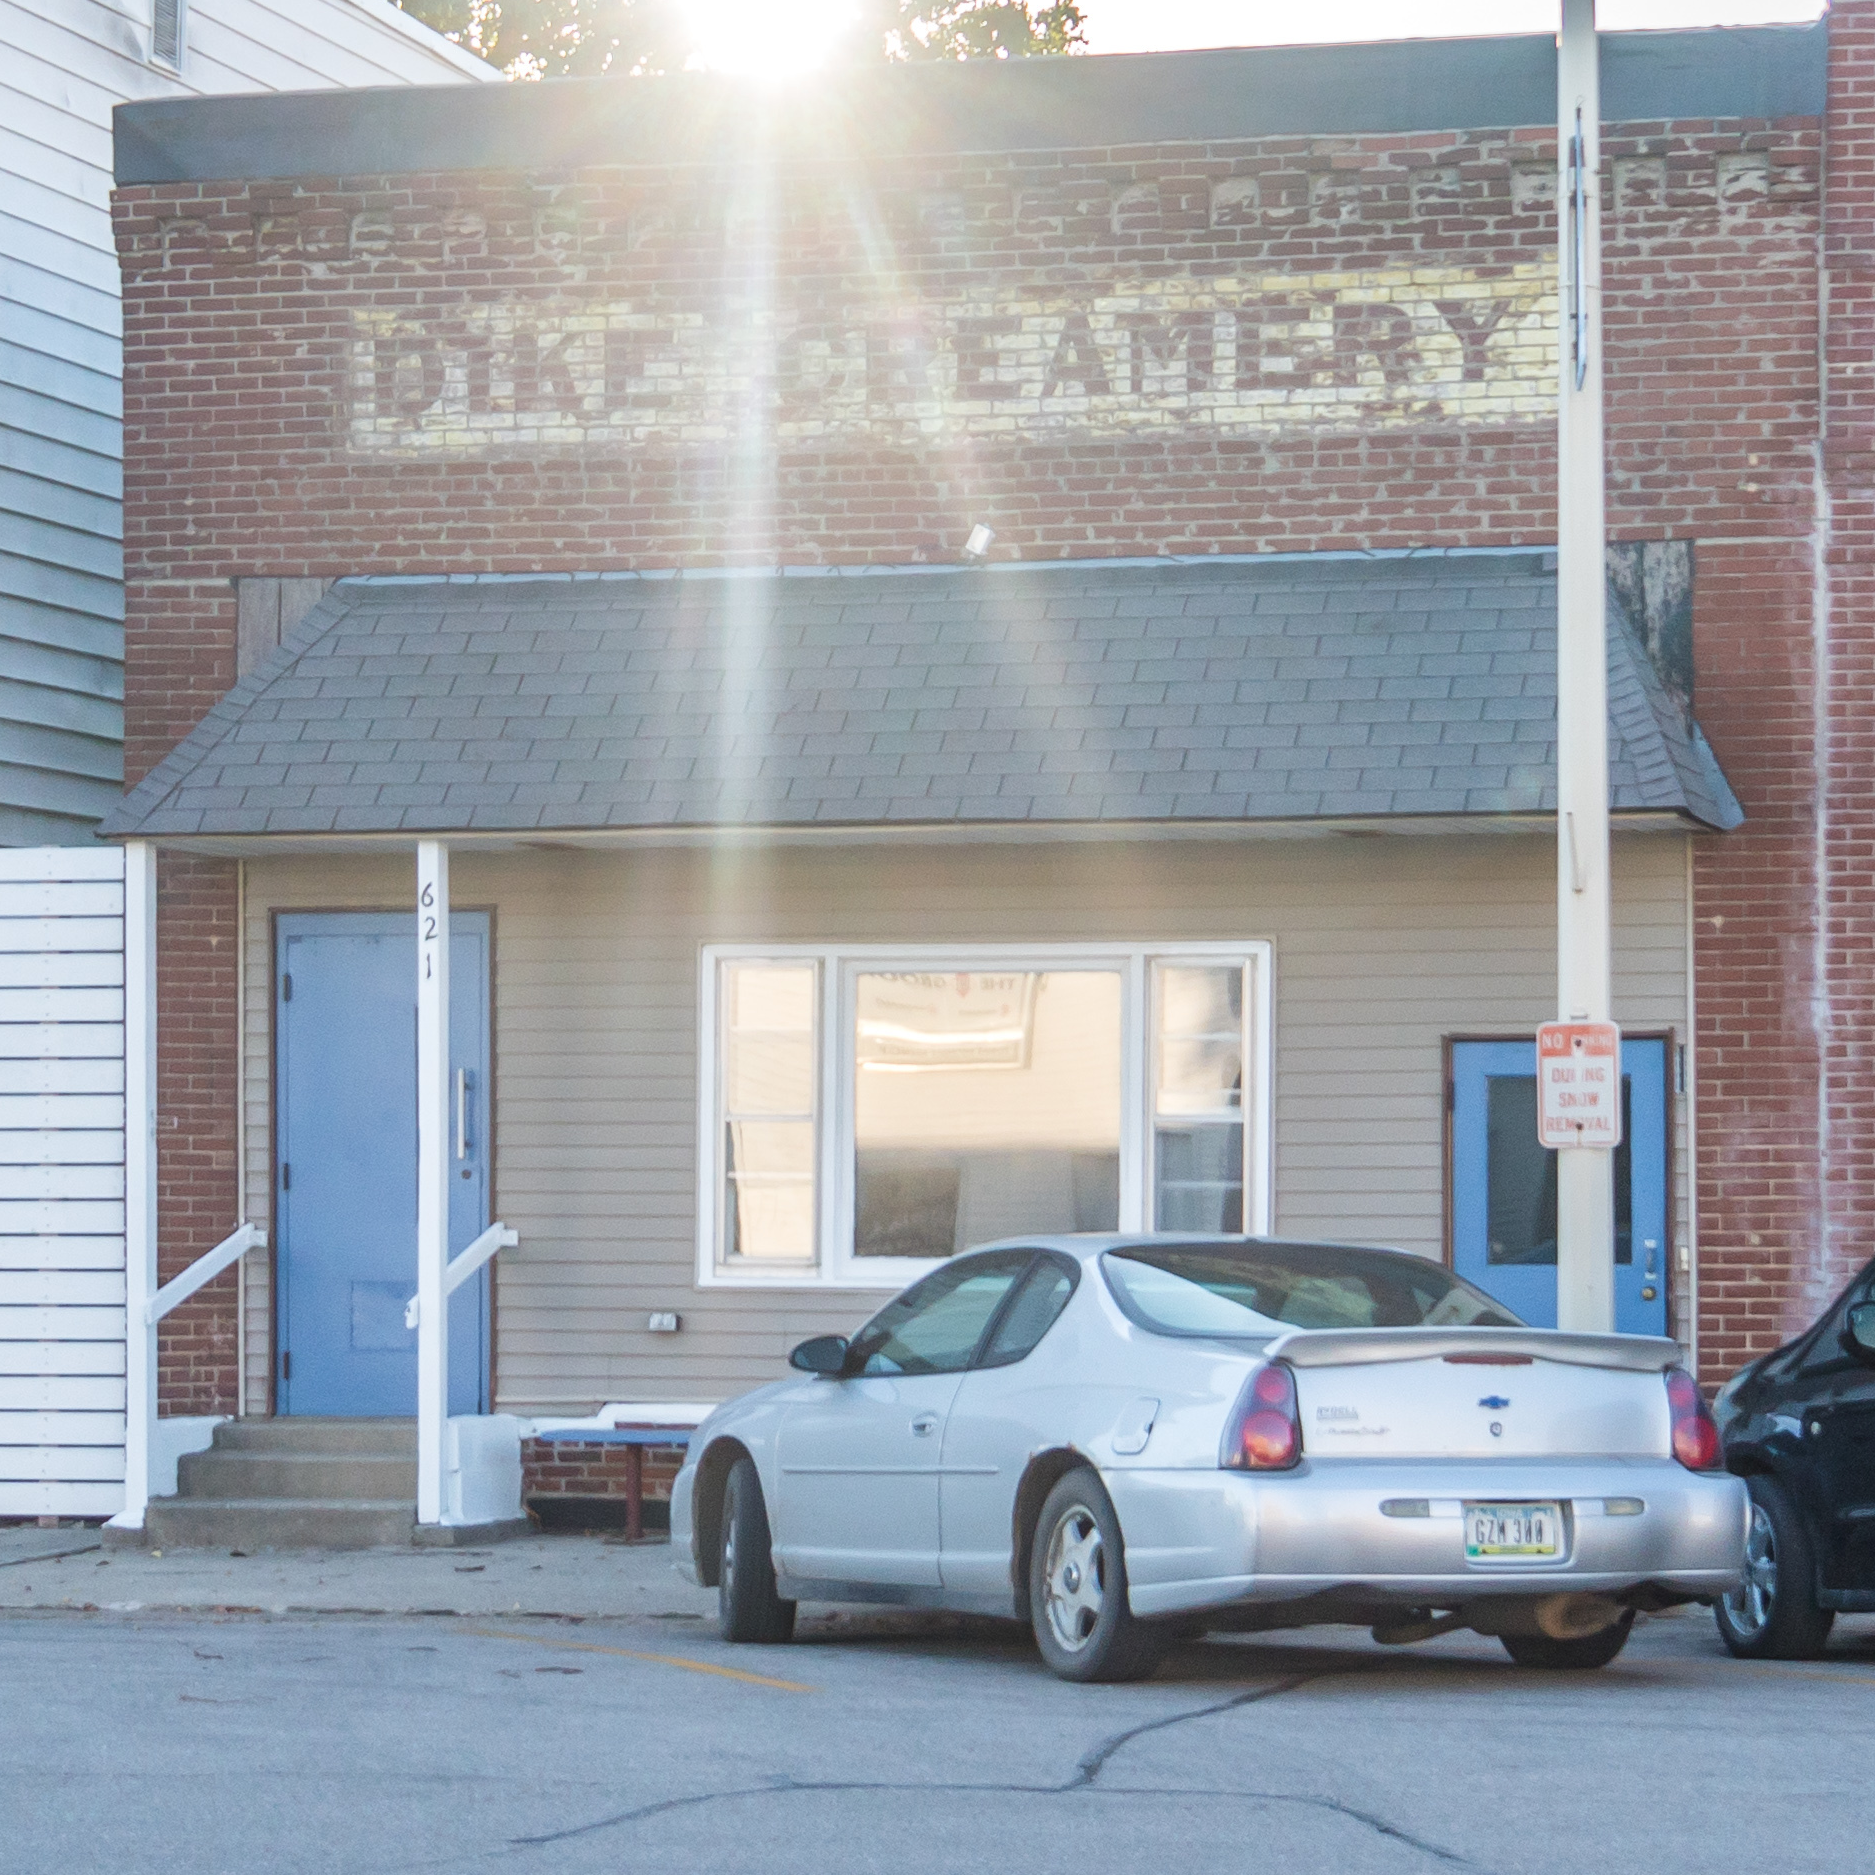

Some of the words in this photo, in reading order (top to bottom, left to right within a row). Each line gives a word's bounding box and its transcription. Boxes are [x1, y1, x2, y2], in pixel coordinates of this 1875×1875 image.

[373, 323, 679, 427] DIKE
[421, 882, 438, 979] 621
[1542, 1033, 1564, 1049] NO
[1572, 1033, 1614, 1047] RKING
